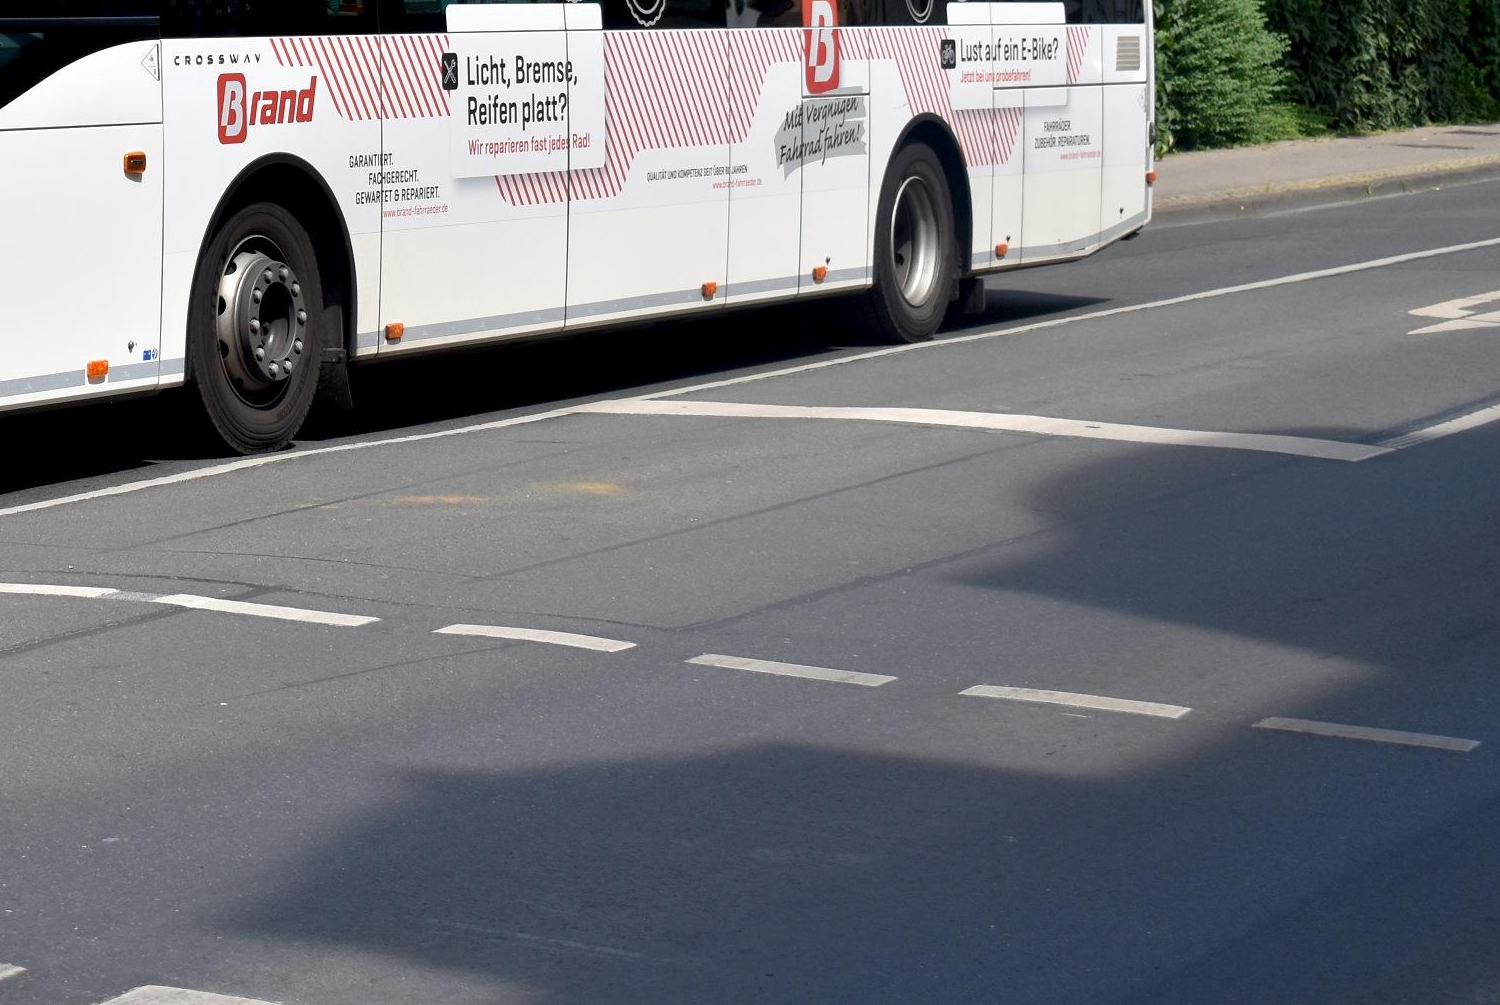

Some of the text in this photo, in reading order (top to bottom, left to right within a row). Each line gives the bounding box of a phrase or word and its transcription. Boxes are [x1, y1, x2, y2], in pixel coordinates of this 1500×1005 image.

[961, 37, 1058, 62] Lust auf ein E-Bike?
[467, 55, 577, 89] Licht, Bremse,
[961, 71, 974, 83] Jetzt
[976, 70, 984, 82] bei
[218, 75, 317, 142] Brand
[468, 92, 567, 131] Reifen platt?
[468, 133, 590, 158] Wir reparieren fast jedes Rad!
[821, 124, 861, 166] fahren!
[349, 153, 394, 168] GARANTIERT.
[368, 170, 419, 185] FACHGERECHT.
[355, 186, 440, 204] GEWARTET & REPARIERT.
